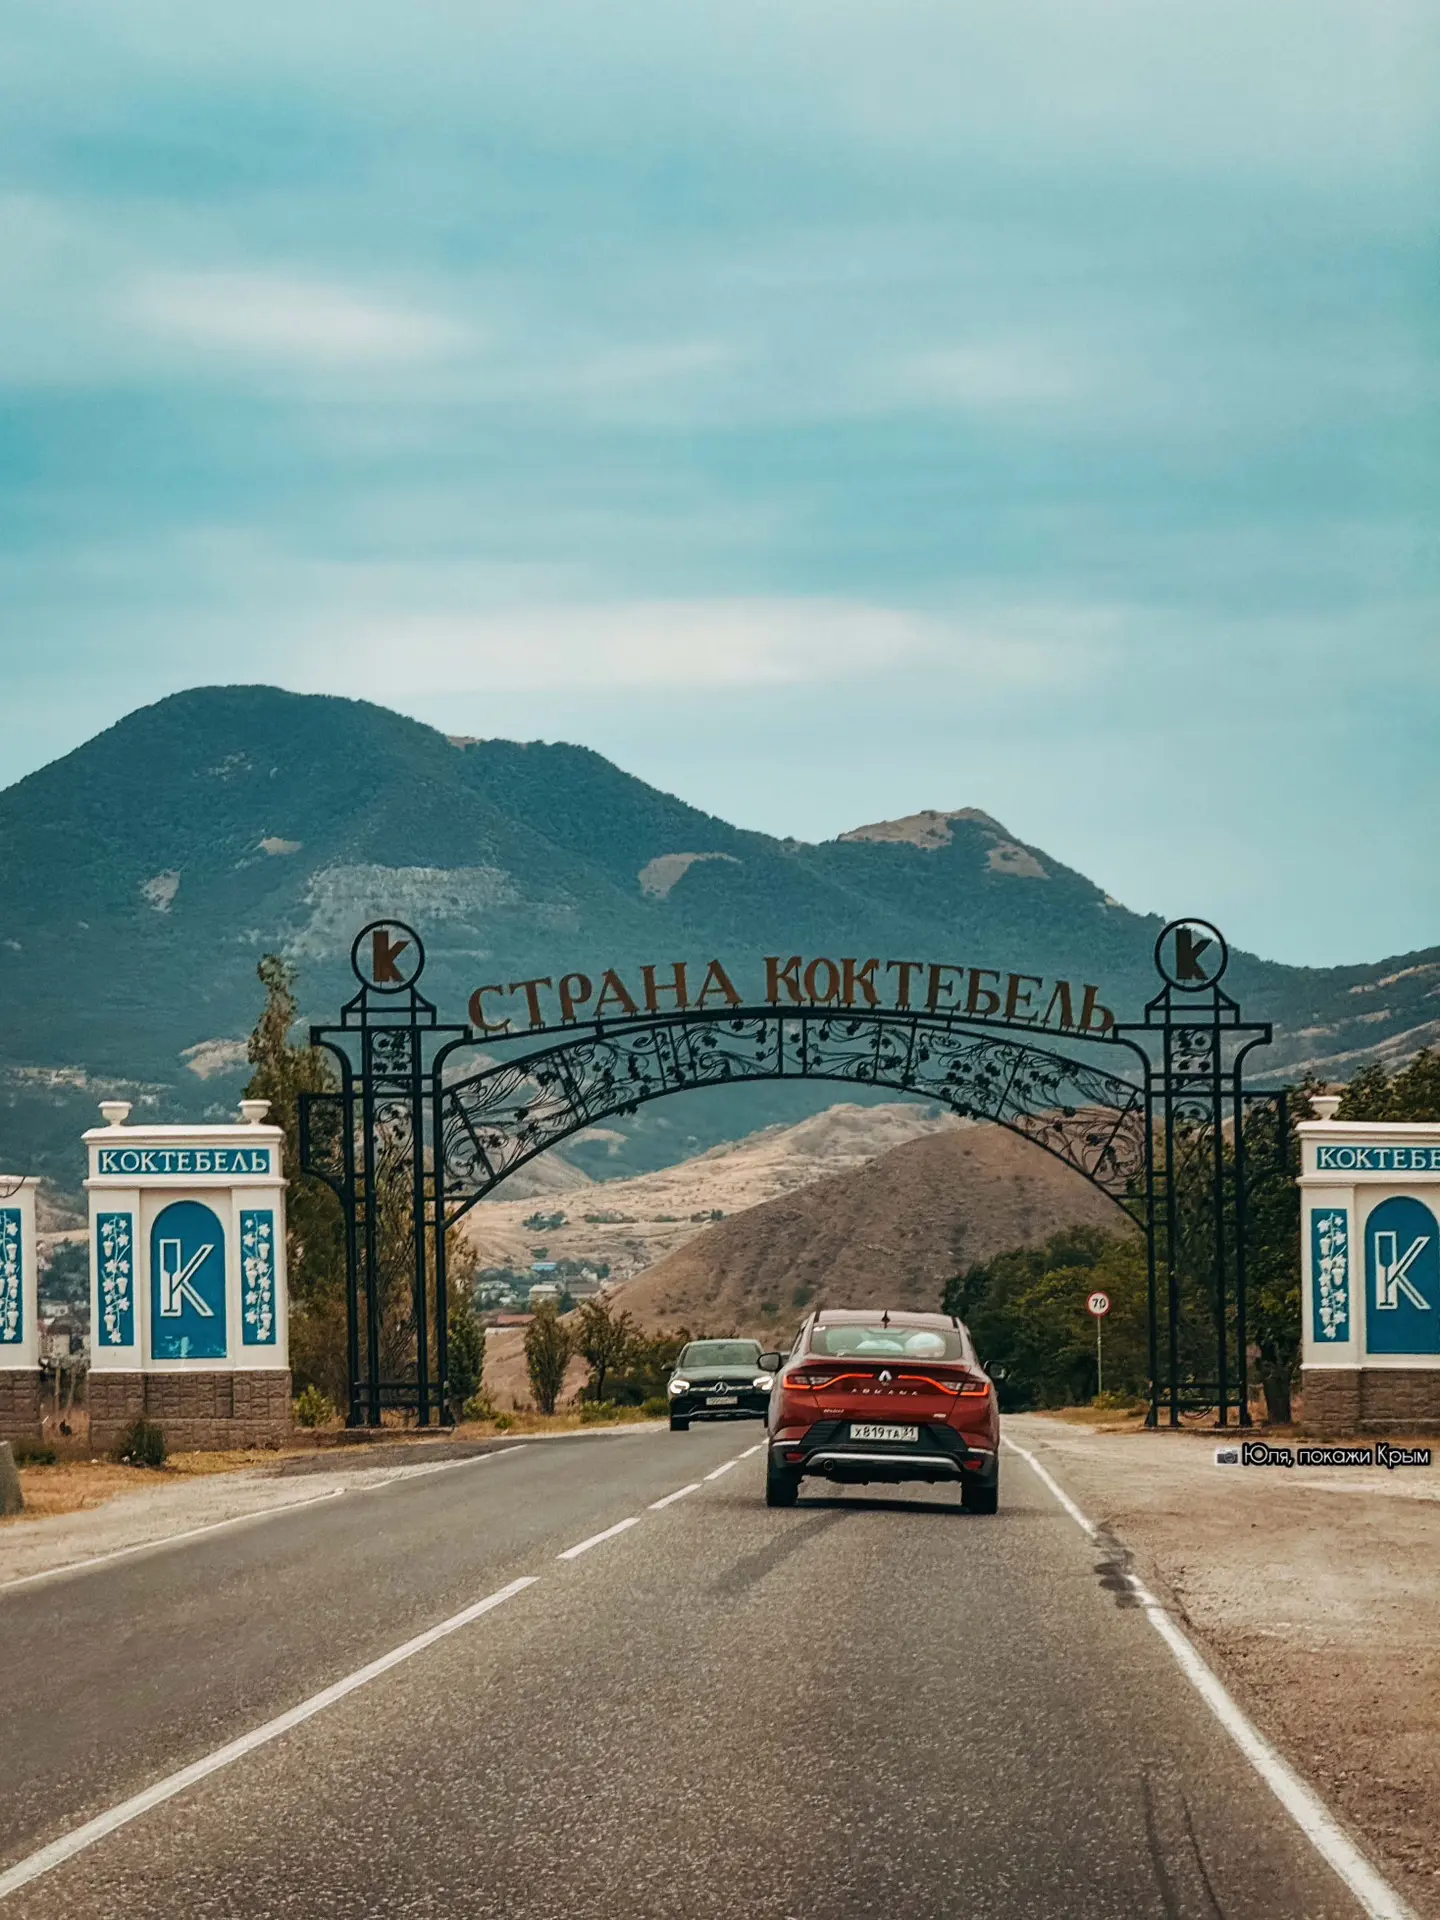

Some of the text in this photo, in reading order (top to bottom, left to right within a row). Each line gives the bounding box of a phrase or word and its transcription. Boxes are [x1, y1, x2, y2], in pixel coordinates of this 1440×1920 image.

[468, 956, 1116, 1032] СТРАНА КОКТЕБЕЛЬ
[101, 1151, 268, 1172] КОКТЕБЕЛЬ
[1092, 1297, 1107, 1309] 70
